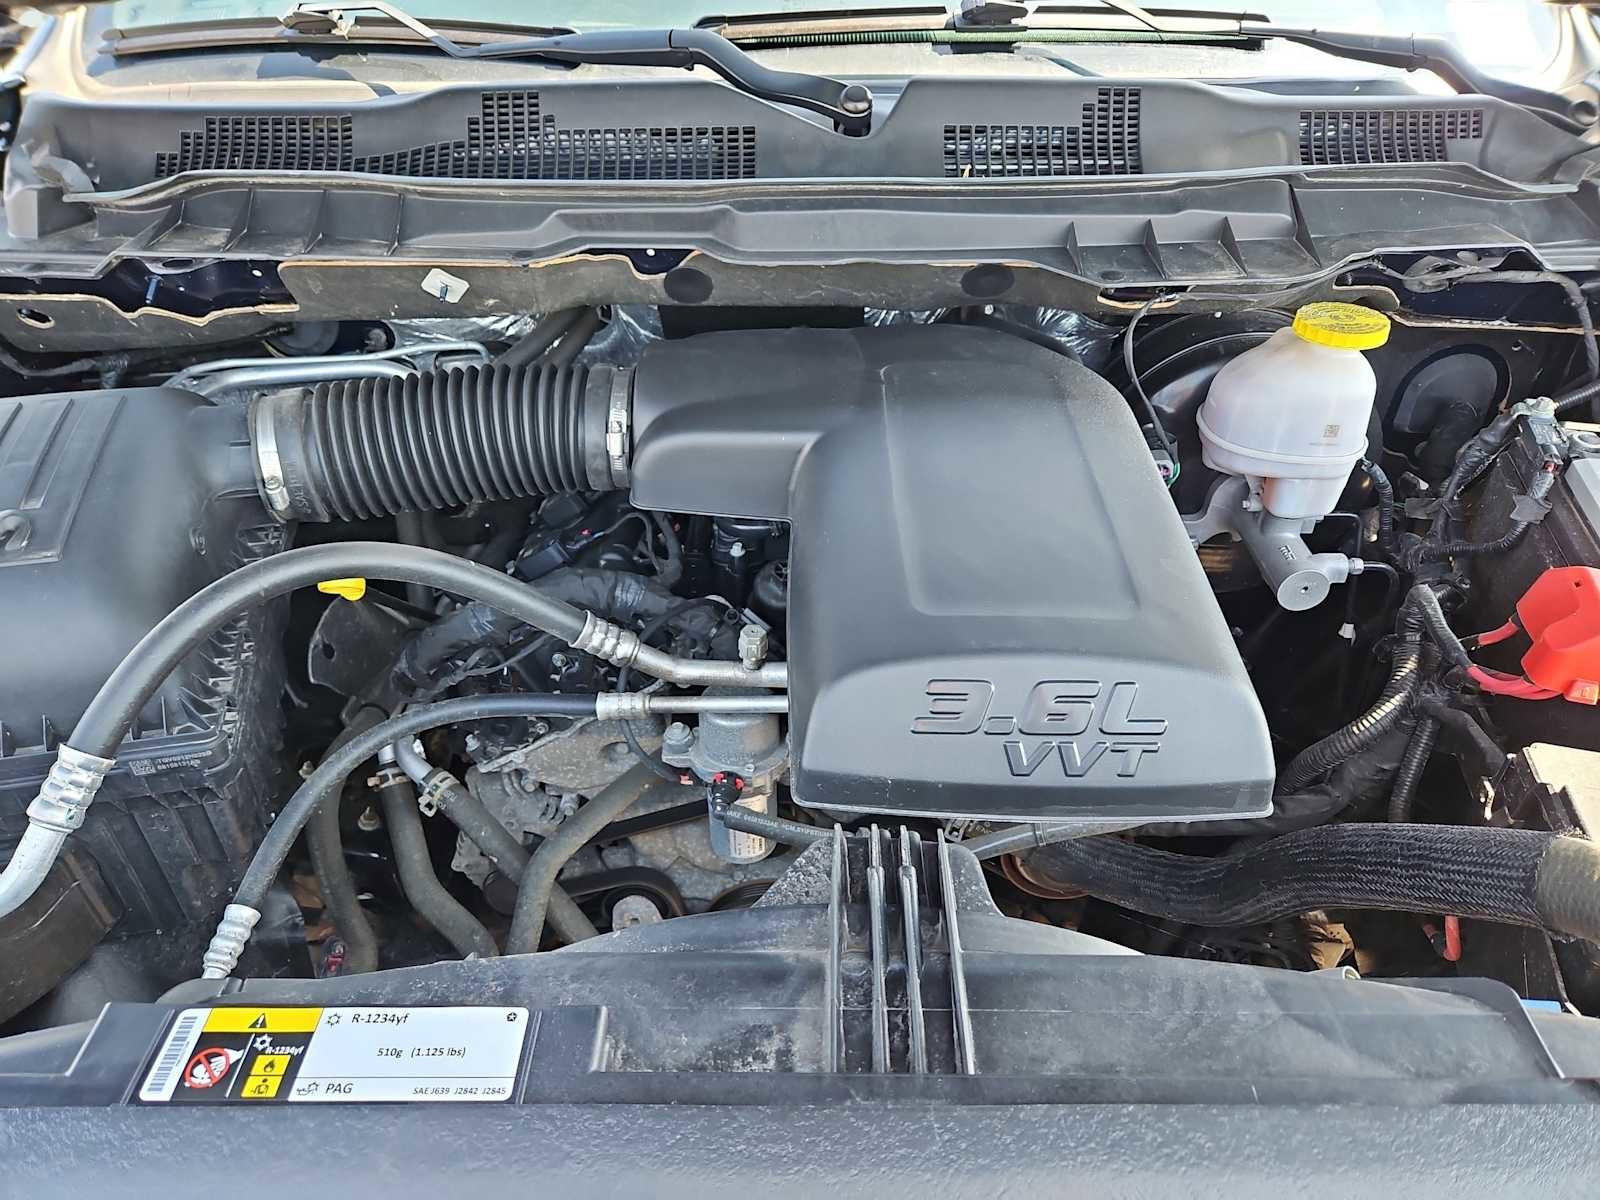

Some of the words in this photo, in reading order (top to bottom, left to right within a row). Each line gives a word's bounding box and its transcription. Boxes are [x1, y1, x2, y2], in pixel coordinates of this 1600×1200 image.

[910, 679, 1168, 735] 3.6L
[1003, 741, 1161, 777] VVT
[351, 1013, 409, 1025] R-1234yf
[376, 1047, 403, 1058] 510g
[410, 1047, 444, 1058] (1.125
[446, 1047, 466, 1058] lbs)
[325, 1083, 354, 1094] PAG
[412, 1087, 428, 1095] SAE
[430, 1087, 450, 1095] J639
